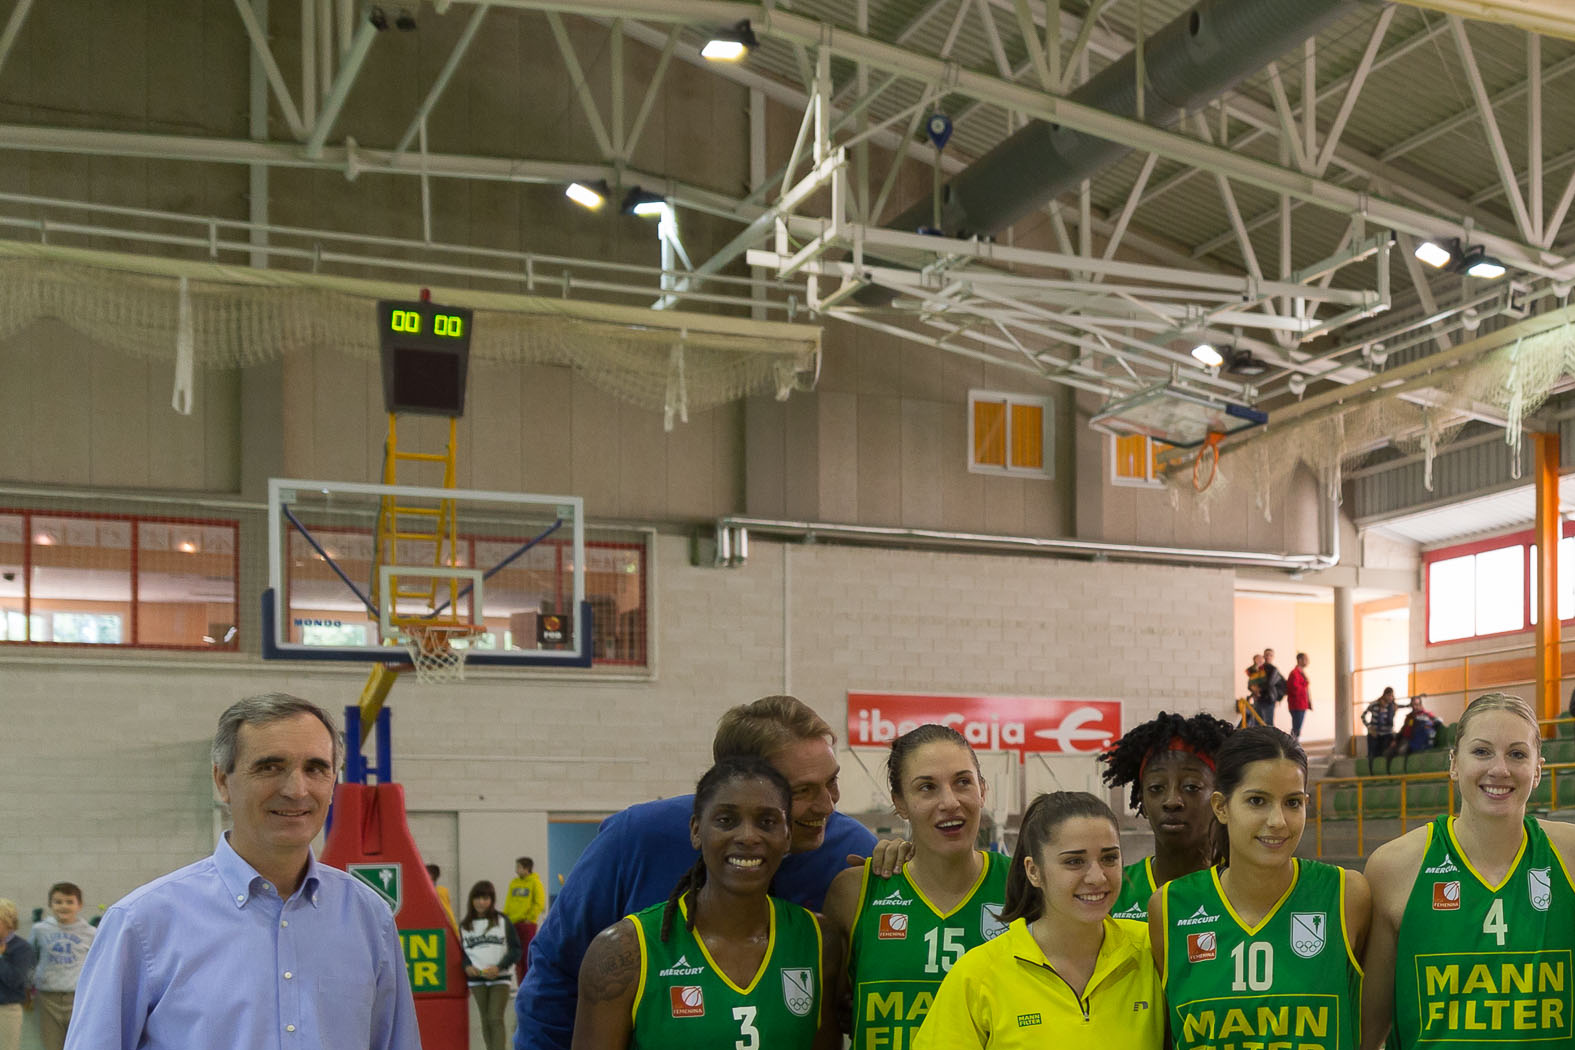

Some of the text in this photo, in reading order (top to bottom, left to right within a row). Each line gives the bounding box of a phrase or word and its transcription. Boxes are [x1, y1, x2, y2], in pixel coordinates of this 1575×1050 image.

[293, 618, 341, 628] MONDO
[1177, 915, 1220, 926] MERCURY
[1483, 898, 1508, 946] 4
[924, 926, 965, 973] 15
[1231, 941, 1274, 991] 10
[659, 966, 705, 977] MERCURY
[1425, 962, 1564, 996] MANN
[1184, 1006, 1329, 1043] MANN
[1425, 999, 1564, 1030] FILTER
